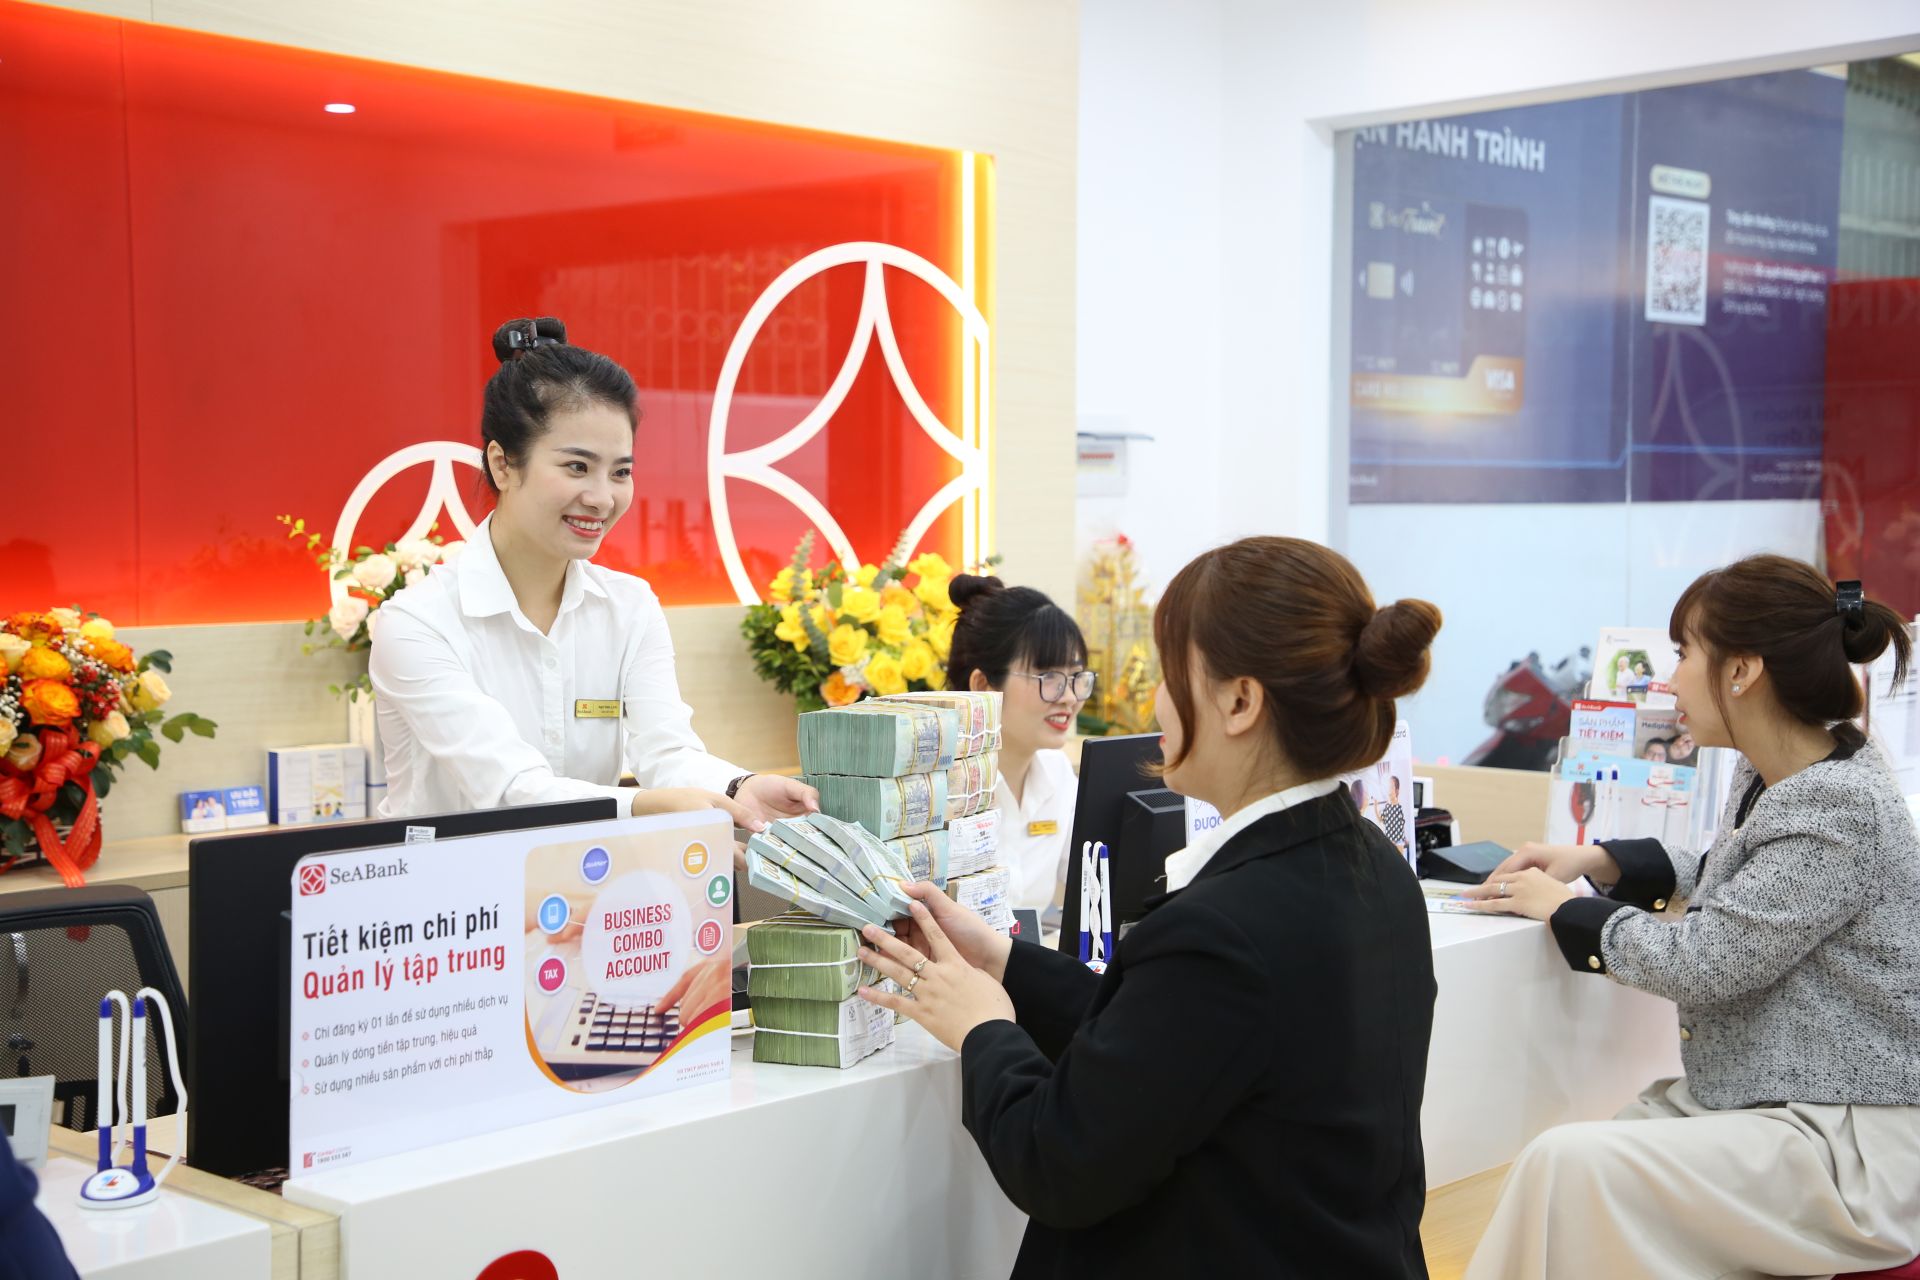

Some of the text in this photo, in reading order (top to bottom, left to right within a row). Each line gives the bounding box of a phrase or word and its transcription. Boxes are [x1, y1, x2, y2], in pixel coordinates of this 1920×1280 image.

[1474, 125, 1546, 173] TRÌNH
[1579, 727, 1624, 741] TIẾT KIỆM
[330, 858, 409, 884] SeABank
[604, 903, 672, 931] BUSINESS
[303, 903, 500, 960] Tiết kiệm chi phí
[613, 929, 663, 953] COMBO
[303, 944, 506, 1000] Quản lý tập trung
[544, 968, 559, 981] TAX
[605, 951, 670, 980] ACCOUNT
[371, 1016, 382, 1029] 01
[428, 1003, 450, 1020] dụng
[478, 995, 496, 1010] dịch
[498, 994, 508, 1006] vụ
[330, 1076, 353, 1095] dụng
